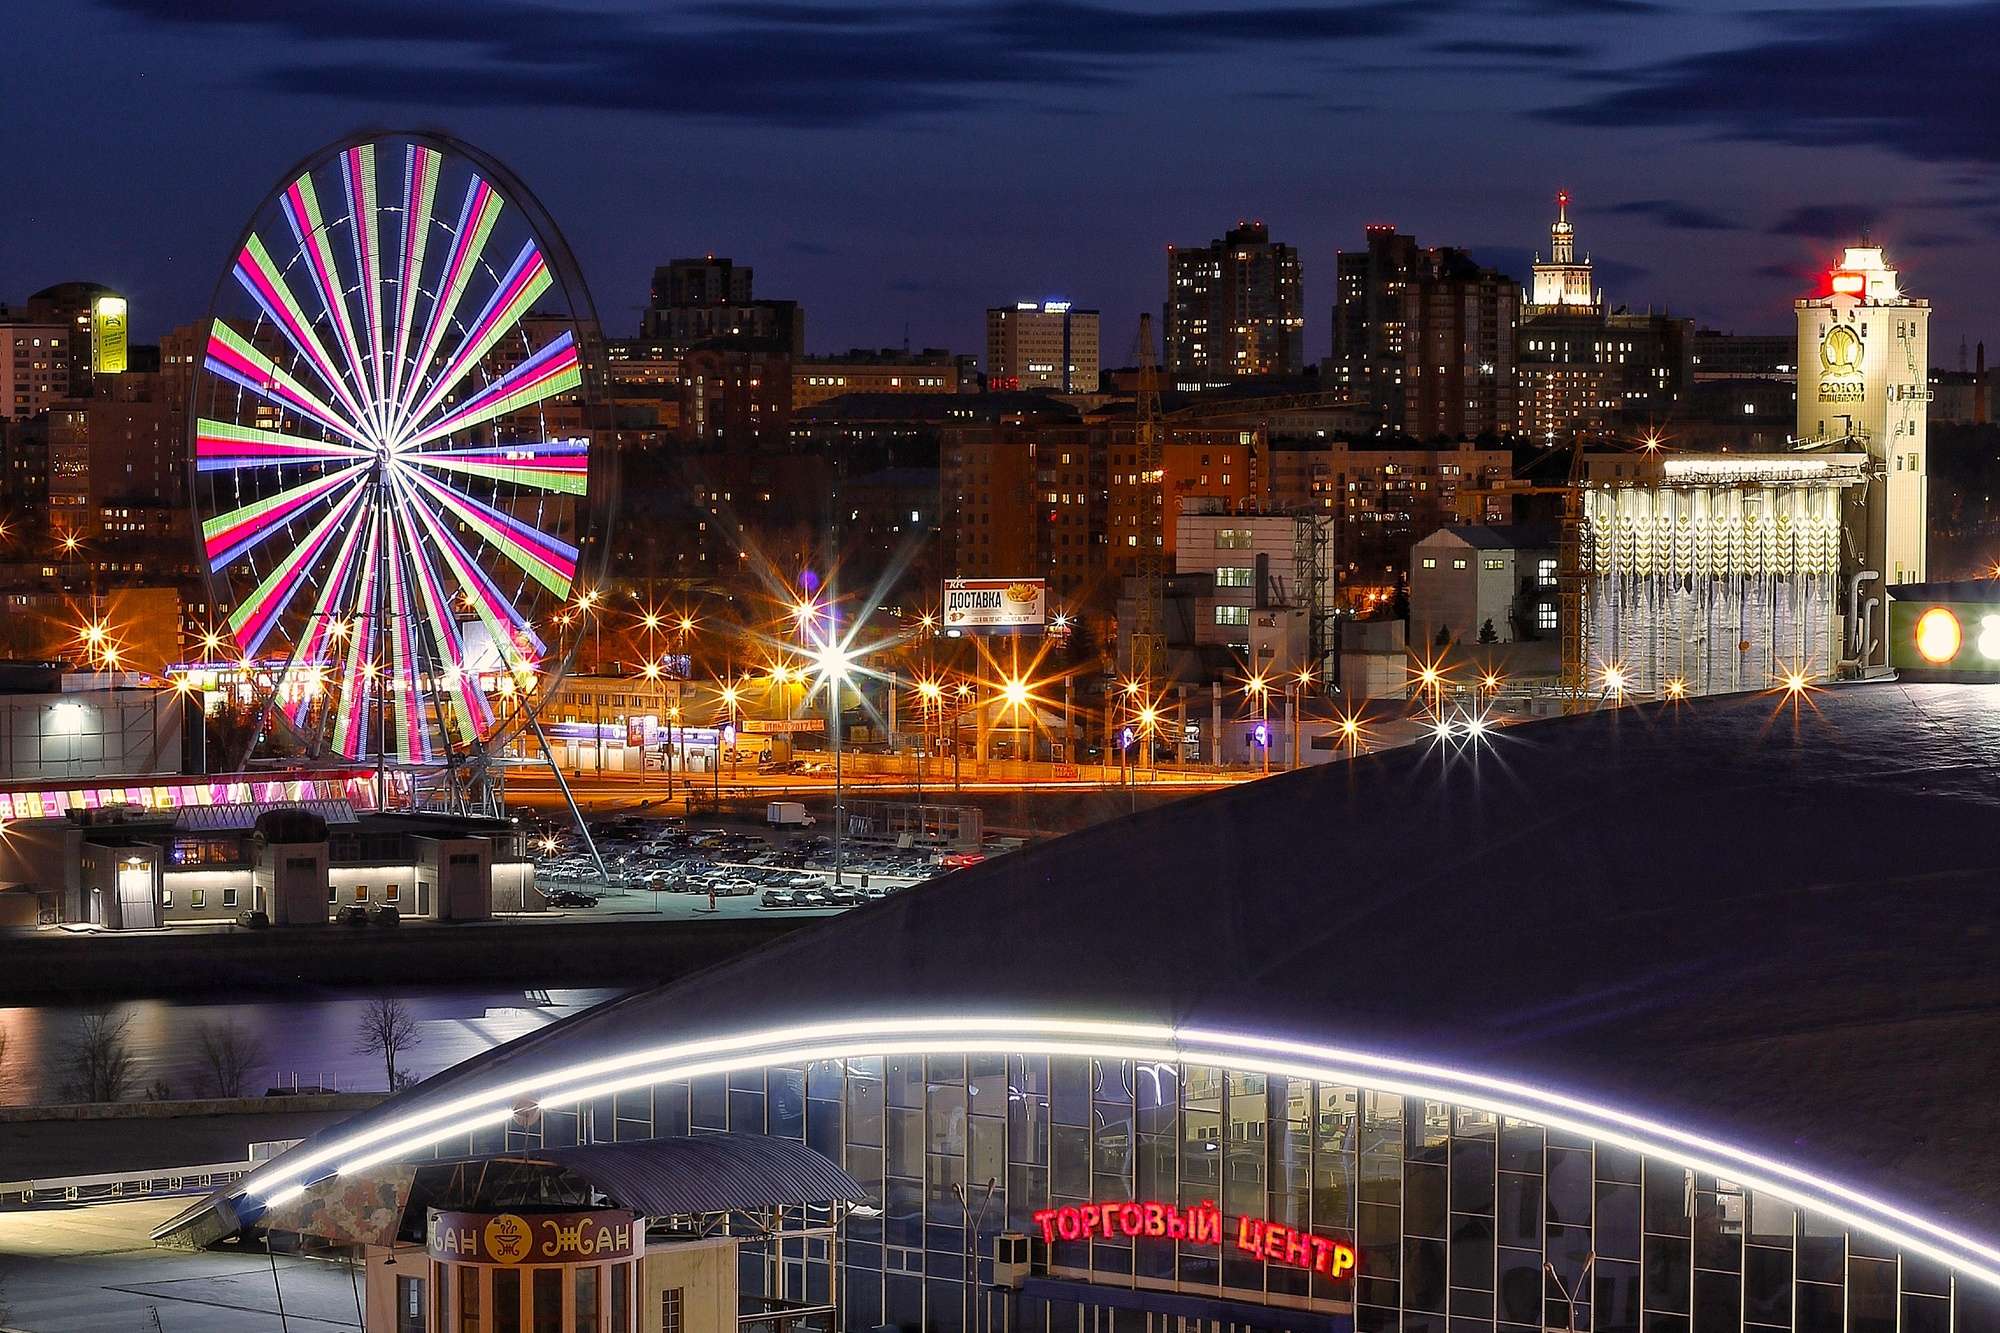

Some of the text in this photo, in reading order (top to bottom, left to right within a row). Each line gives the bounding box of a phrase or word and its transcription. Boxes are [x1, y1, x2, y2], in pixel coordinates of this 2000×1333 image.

[949, 581, 966, 589] KFC
[948, 591, 1002, 611] ДОСТАВКА
[1033, 1200, 1355, 1279] ТОРГОВЫЙ ЦЕНТР
